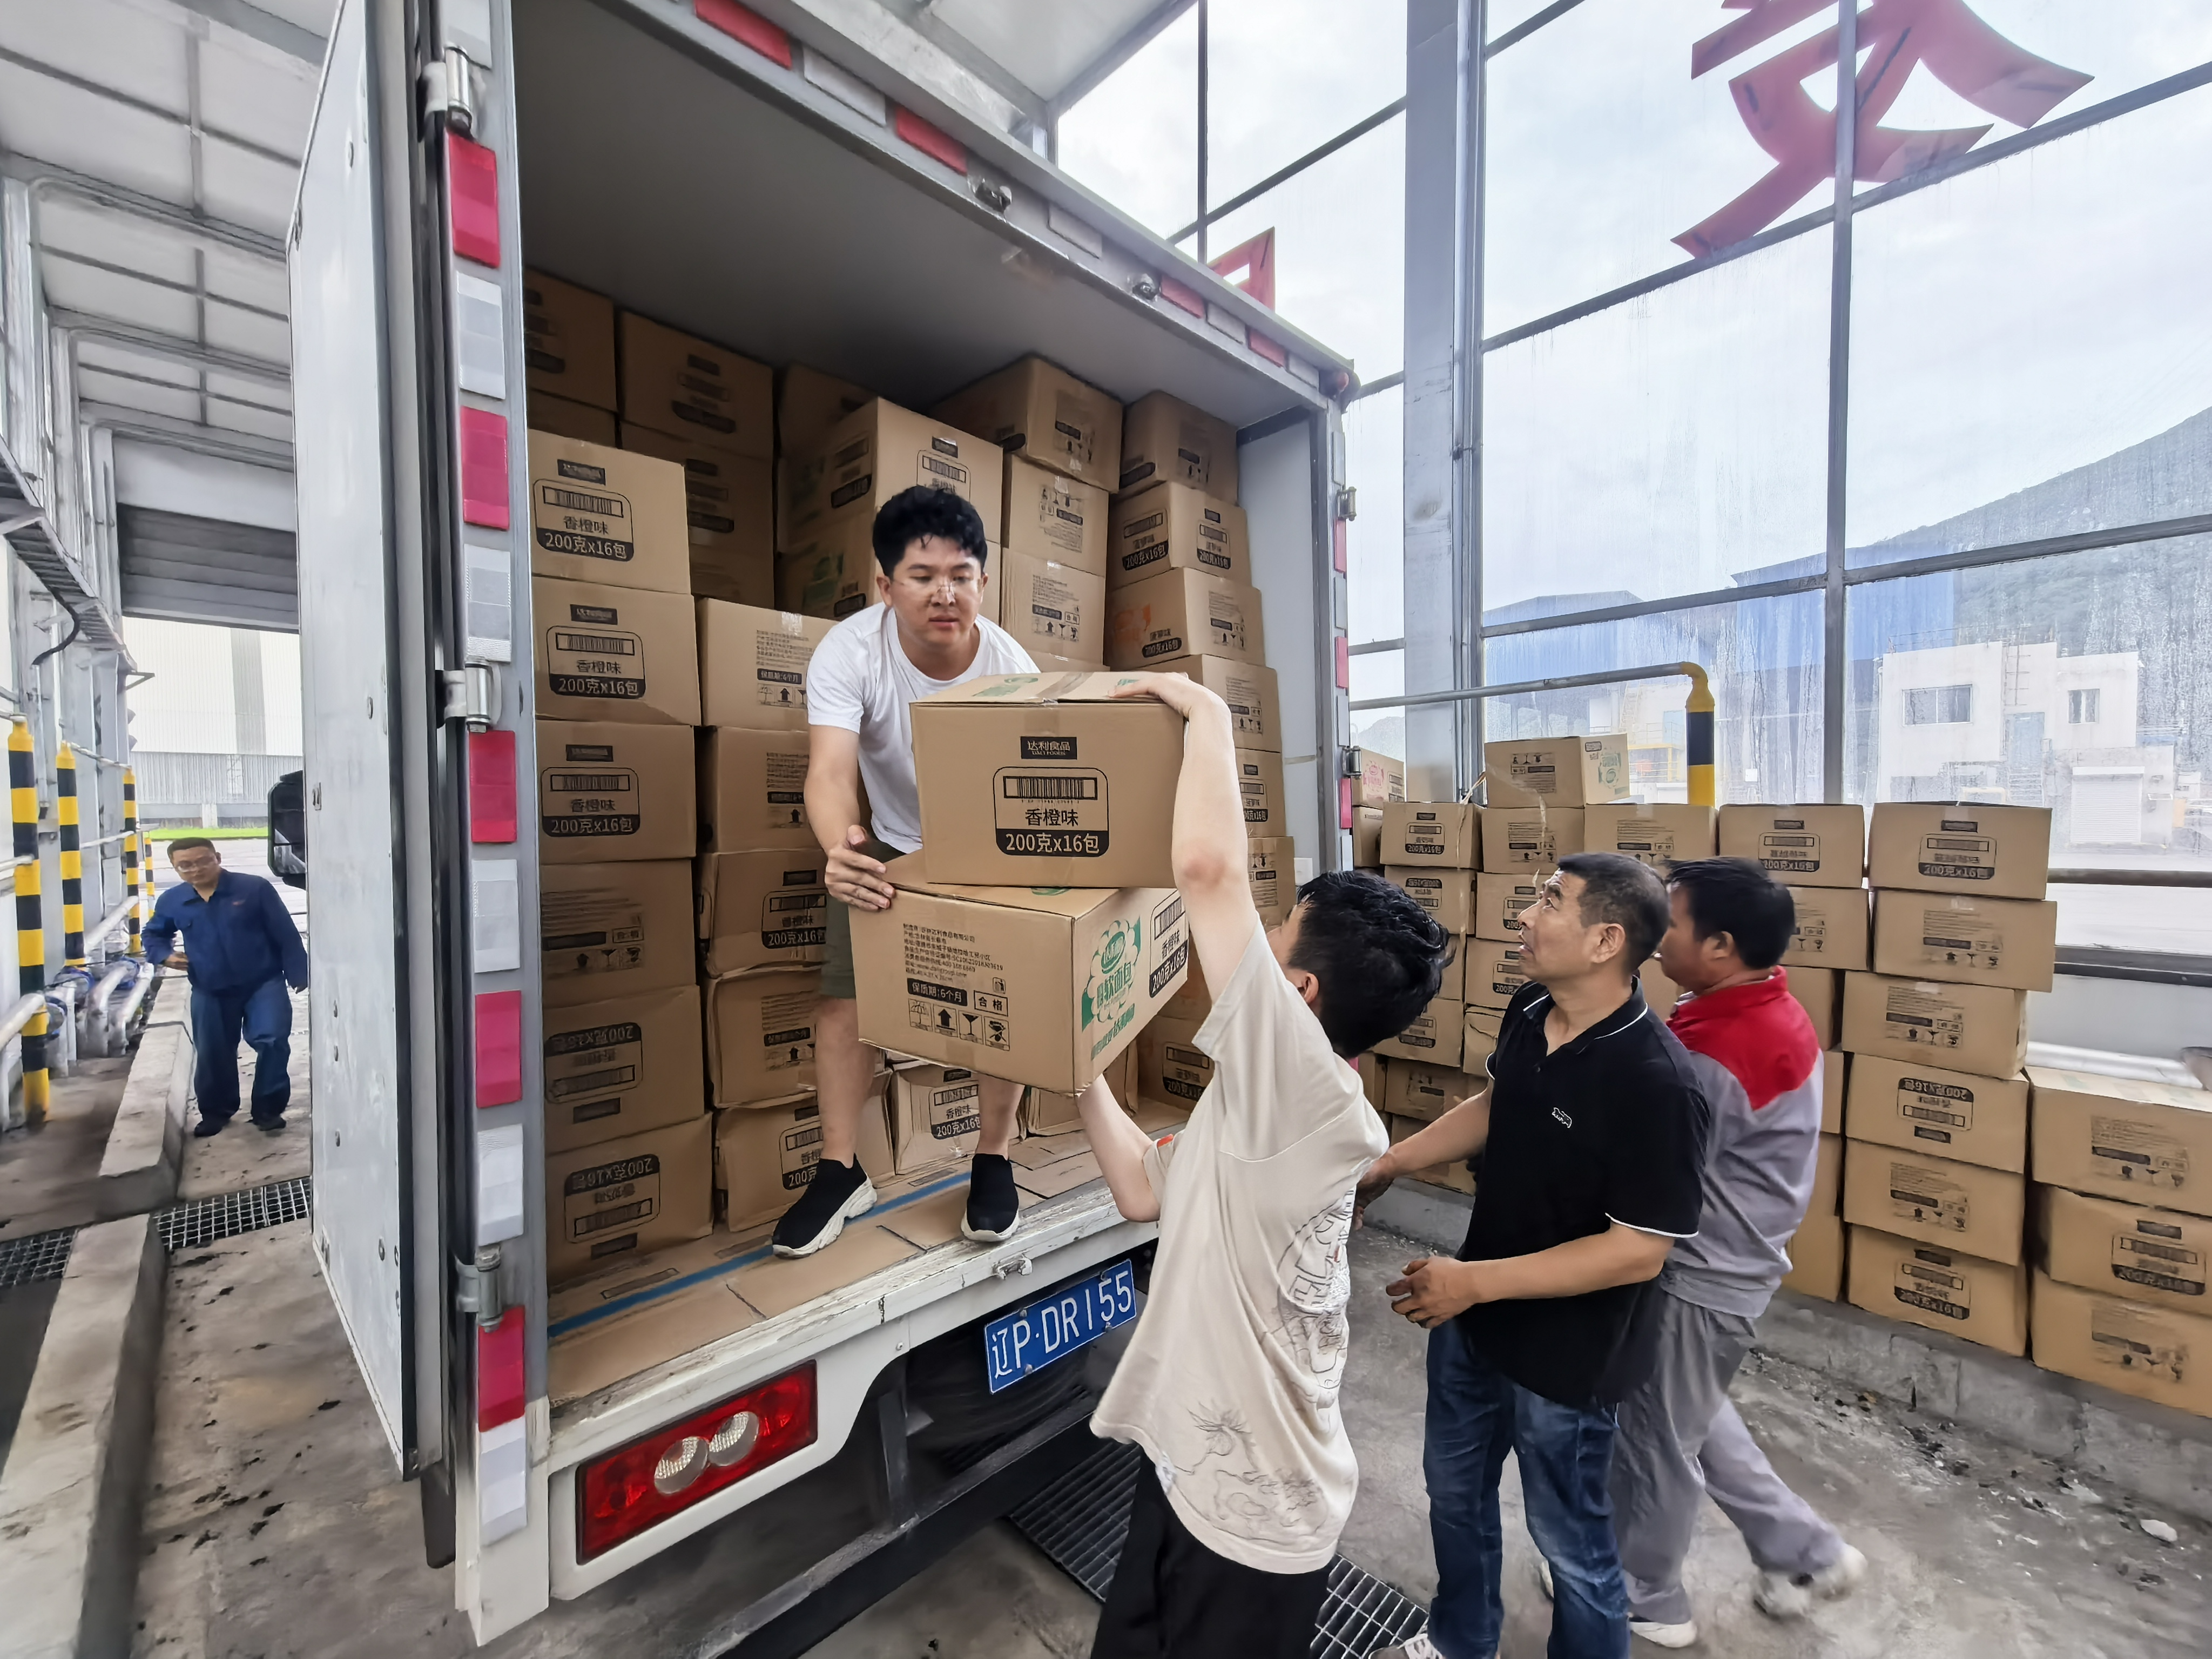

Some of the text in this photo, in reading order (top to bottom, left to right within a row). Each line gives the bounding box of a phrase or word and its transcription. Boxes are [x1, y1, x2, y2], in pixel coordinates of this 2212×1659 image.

[563, 516, 609, 535] 香橙味
[545, 532, 626, 558] 200克x16包
[577, 660, 621, 674] 香橙味
[558, 678, 638, 695] 200克x16包
[1027, 741, 1070, 751] 达利食品
[551, 817, 632, 833] 200克x16包
[1025, 808, 1078, 827] 香橙味
[1006, 832, 1100, 854] 200克x16包
[1162, 928, 1180, 960] 香橙味
[1152, 945, 1185, 993] 200克x16包
[912, 982, 962, 1002] 保质期:6个月
[979, 996, 1002, 1011] 合格
